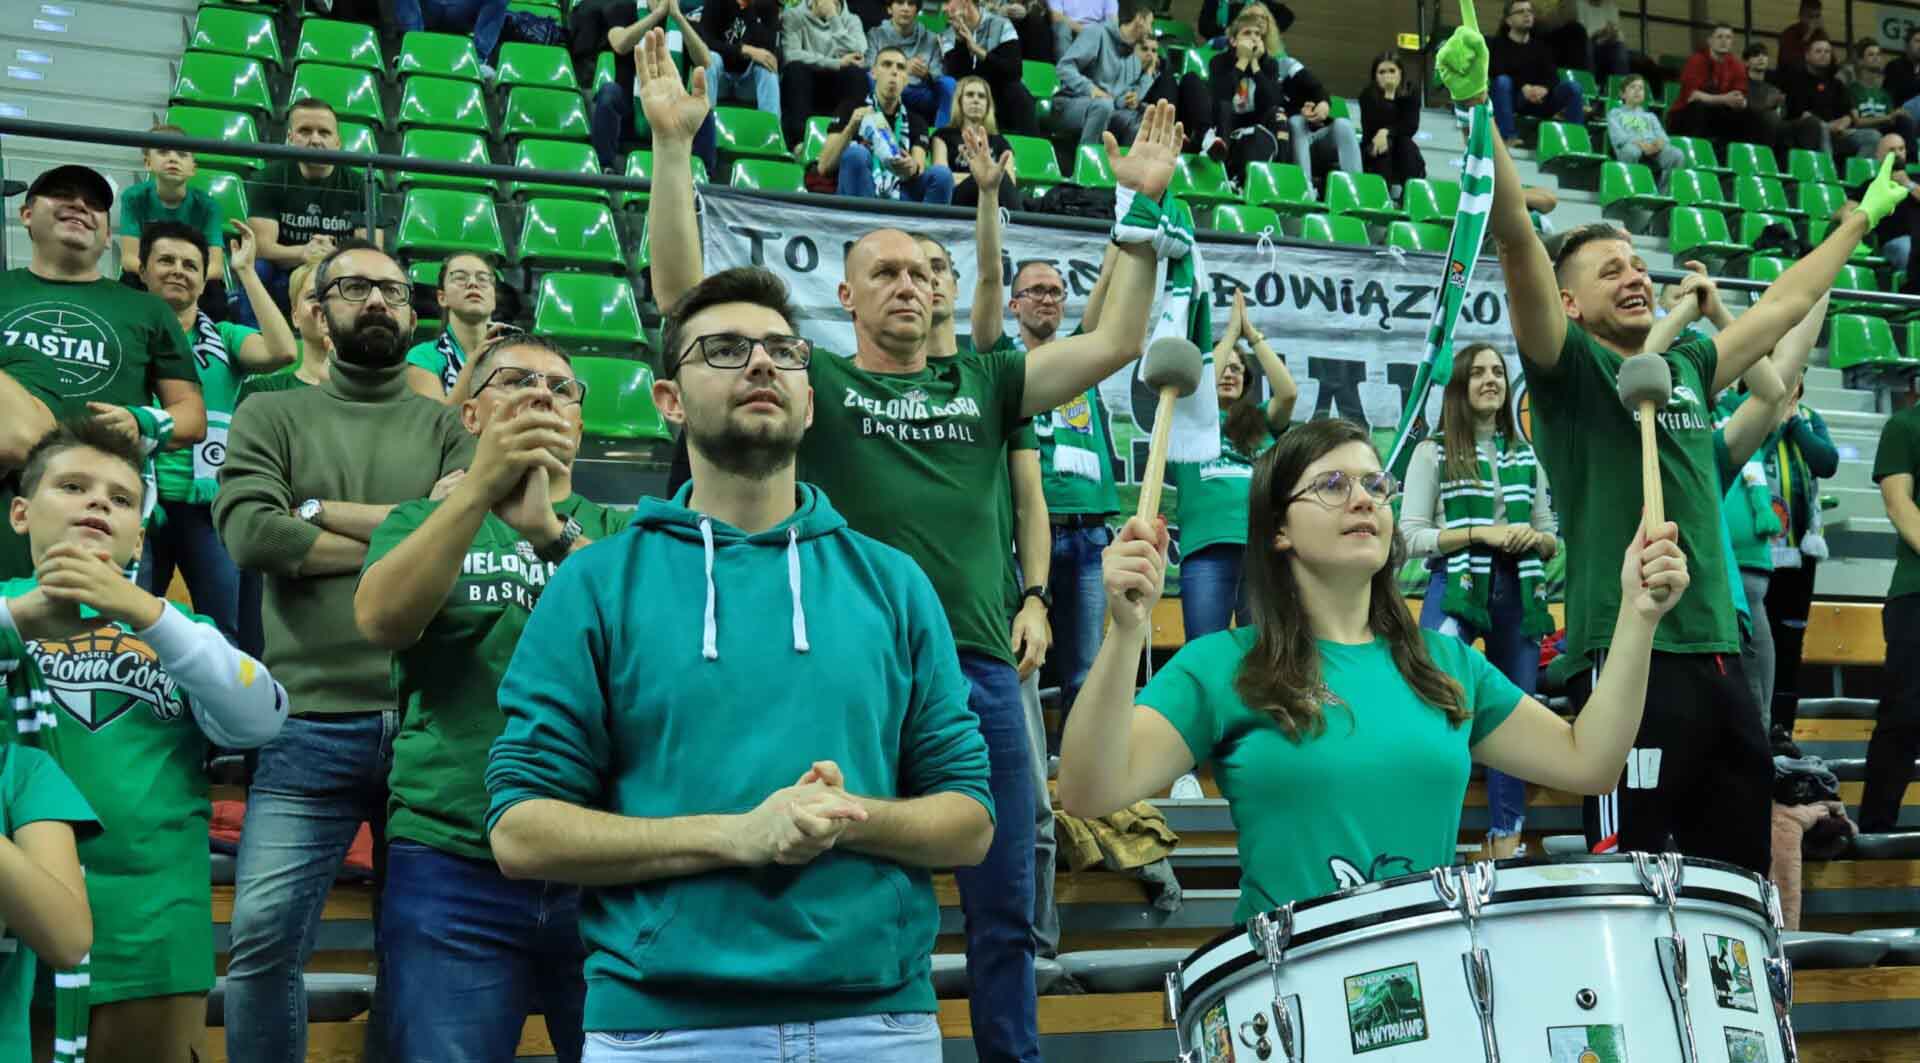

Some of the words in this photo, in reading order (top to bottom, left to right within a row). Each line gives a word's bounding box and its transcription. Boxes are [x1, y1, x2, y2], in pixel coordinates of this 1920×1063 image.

[728, 225, 819, 273] TO
[3, 330, 111, 366] ZASTAL
[844, 387, 929, 419] ZIELONA
[863, 418, 975, 442] BASKETBALL
[73, 652, 113, 662] BASKET
